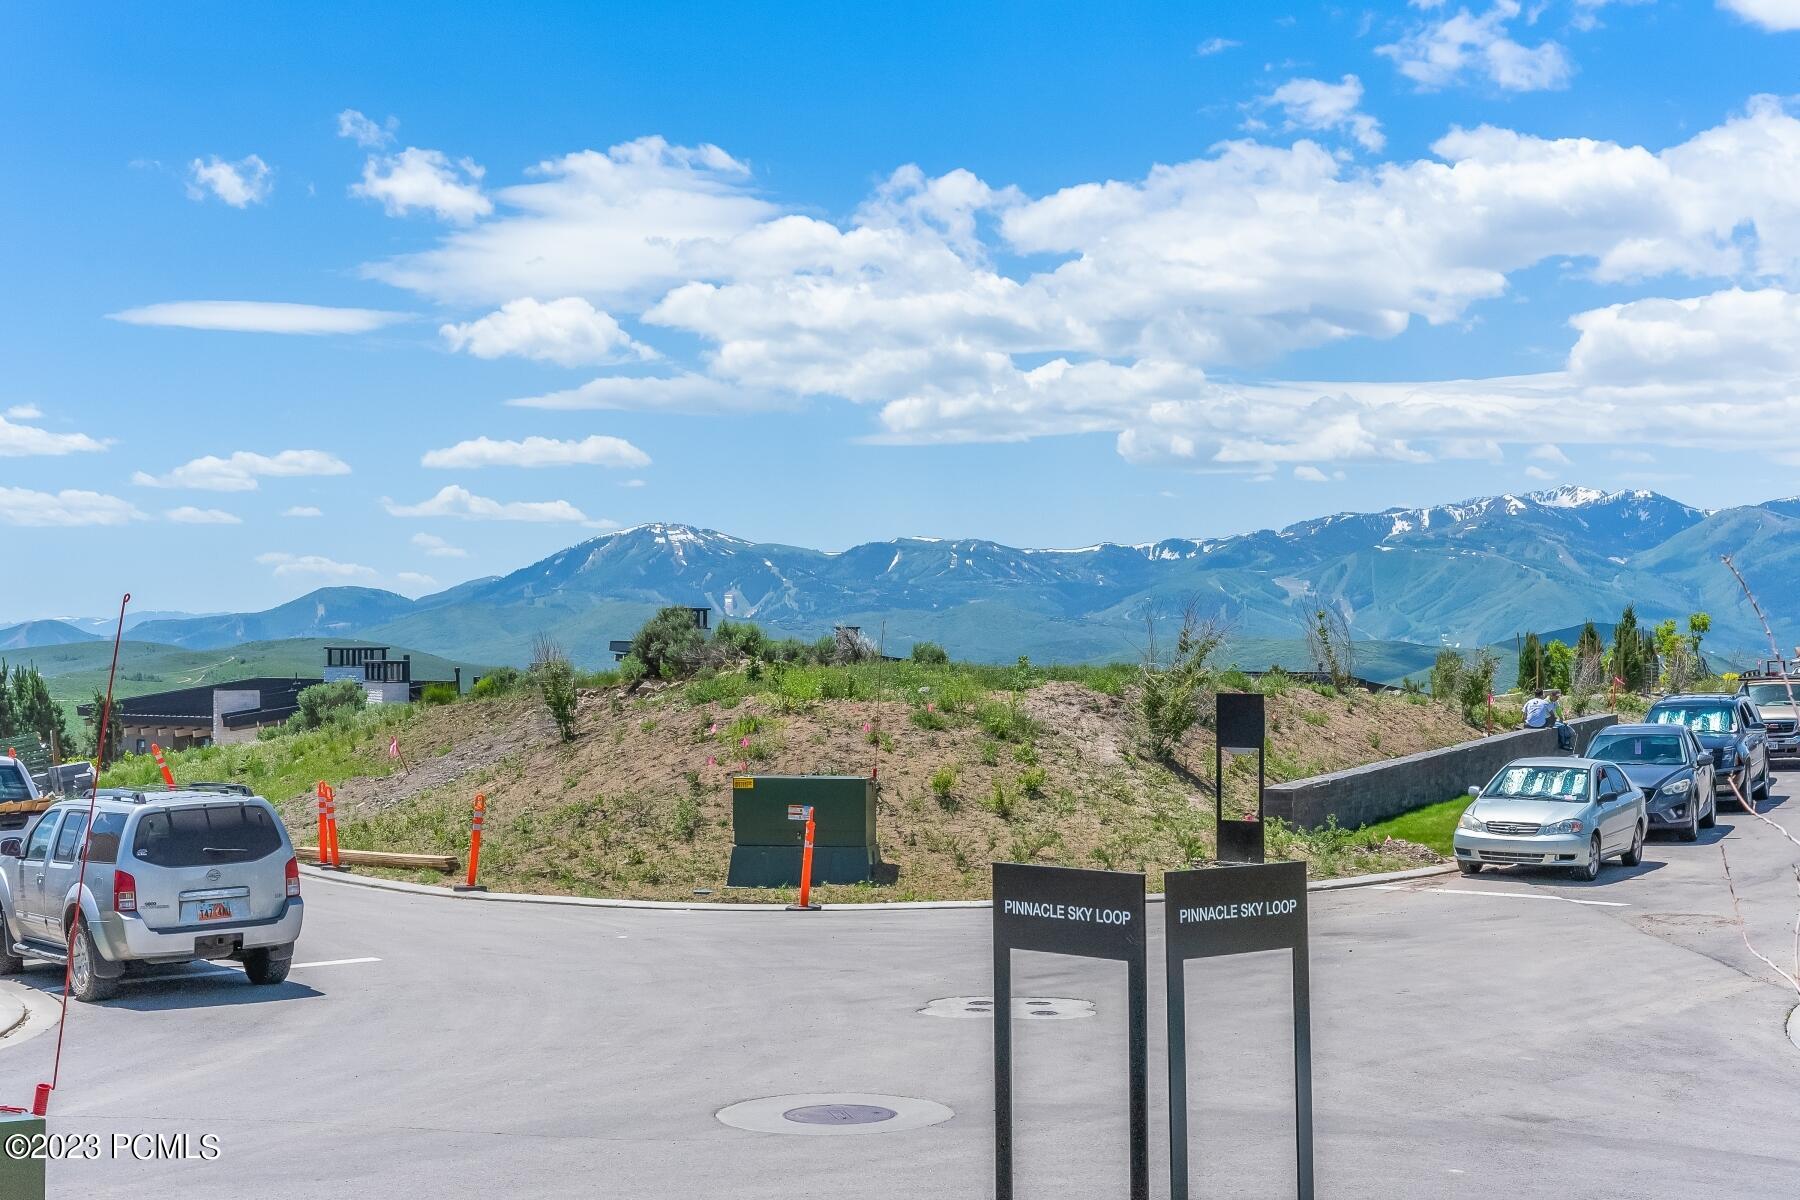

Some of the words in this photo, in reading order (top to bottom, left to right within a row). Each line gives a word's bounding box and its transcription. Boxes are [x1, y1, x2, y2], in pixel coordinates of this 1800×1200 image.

[1004, 900, 1065, 919] PINNACLE
[1067, 906, 1093, 922] SKY
[1096, 908, 1131, 925] LOOP
[1179, 904, 1238, 924] PINNACLE
[1240, 902, 1264, 917] SKY
[1266, 899, 1297, 915] LOOP
